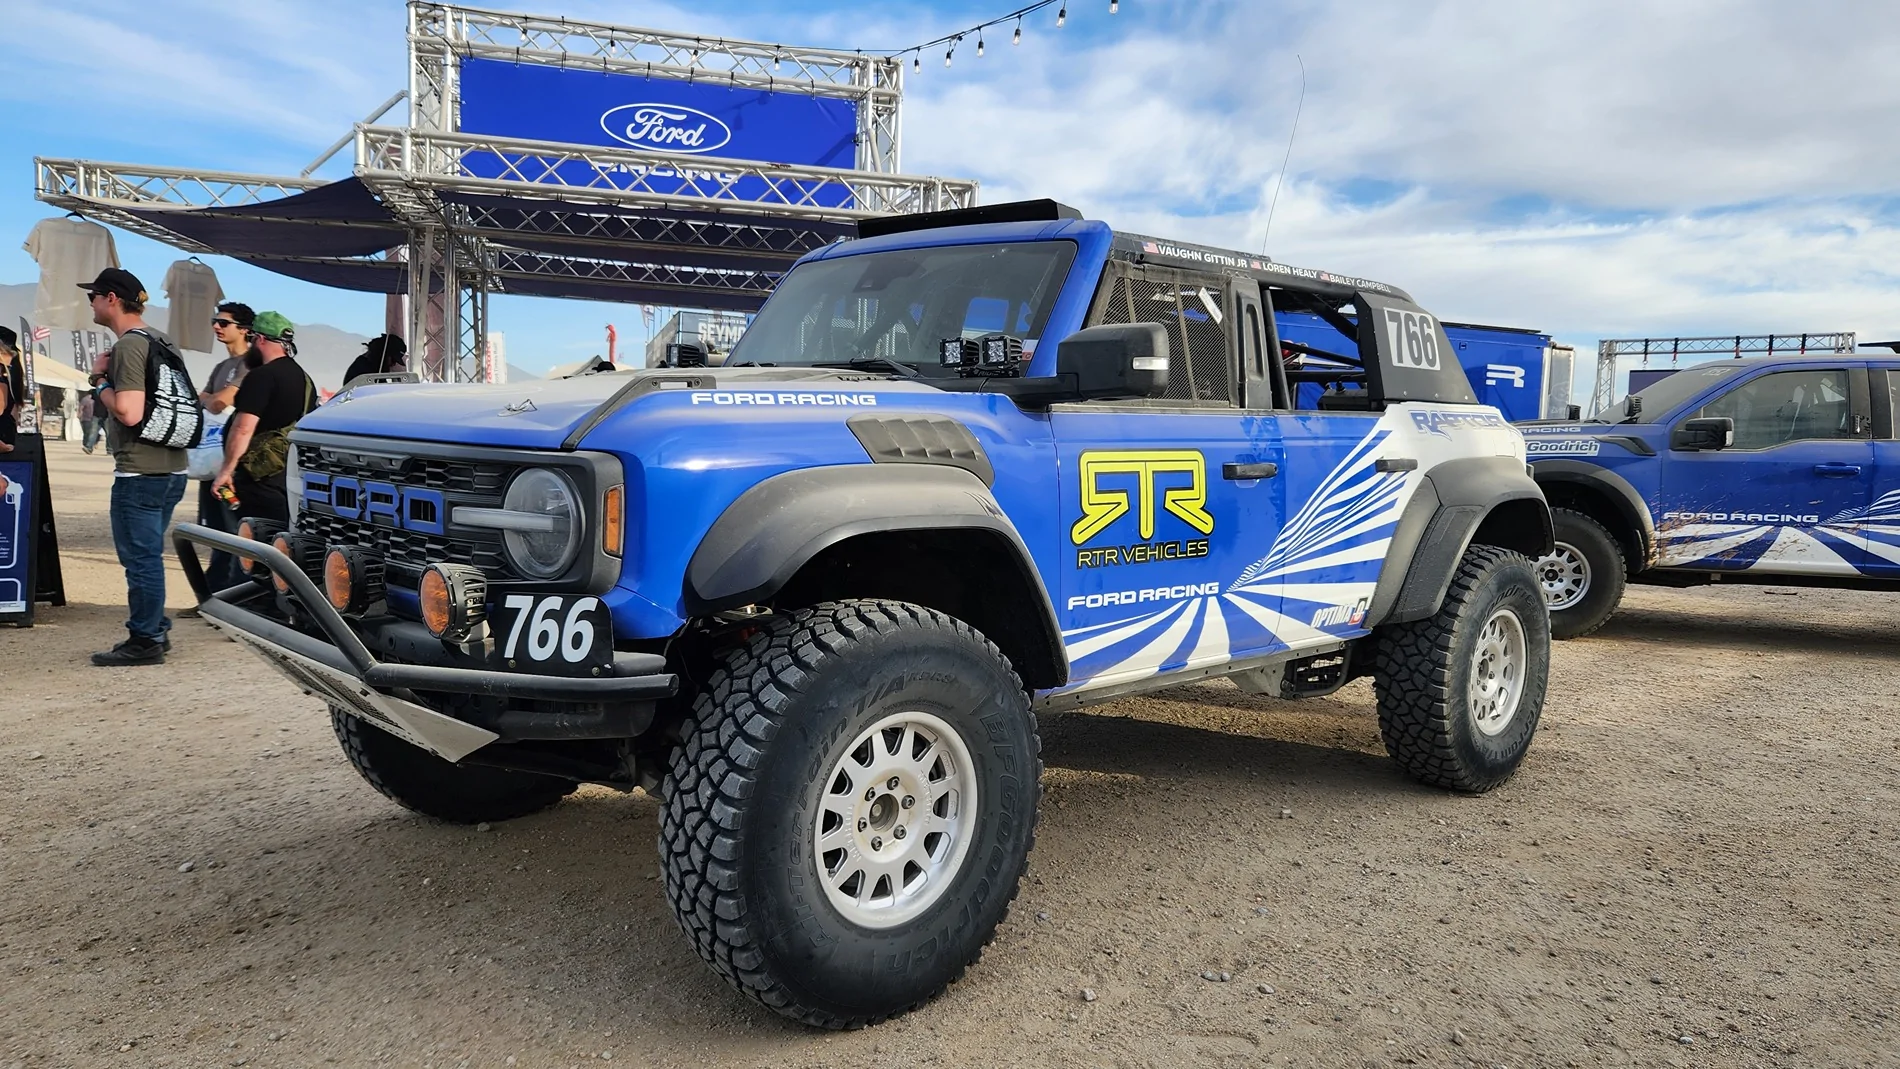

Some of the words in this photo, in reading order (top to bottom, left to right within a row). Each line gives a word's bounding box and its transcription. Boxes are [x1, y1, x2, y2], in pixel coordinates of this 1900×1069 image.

[626, 108, 706, 147] Ford
[1158, 245, 1202, 261] VAUGHN
[1204, 253, 1235, 266] GITTIN
[1236, 258, 1248, 268] JR
[1262, 262, 1291, 275] LOREN
[1292, 268, 1318, 279] HEALY
[1329, 274, 1355, 287] BAILEY
[1356, 279, 1391, 293] CAMPBELL
[1386, 309, 1437, 368] 766
[691, 392, 776, 405] FORD
[779, 393, 877, 406] RACING
[1408, 410, 1503, 439] RAPTOR
[1526, 440, 1599, 452] Goodrich
[303, 471, 444, 535] FORD
[1663, 512, 1728, 521] FORD
[1730, 513, 1819, 523] RACING
[1077, 549, 1118, 568] RTR
[1122, 540, 1209, 563] VEHICLES
[1067, 590, 1137, 610] FORD
[1139, 581, 1220, 602] RACING
[504, 595, 599, 663] 766
[1310, 604, 1356, 628] OPTIMA
[885, 712, 1020, 974] BFGoodrich
